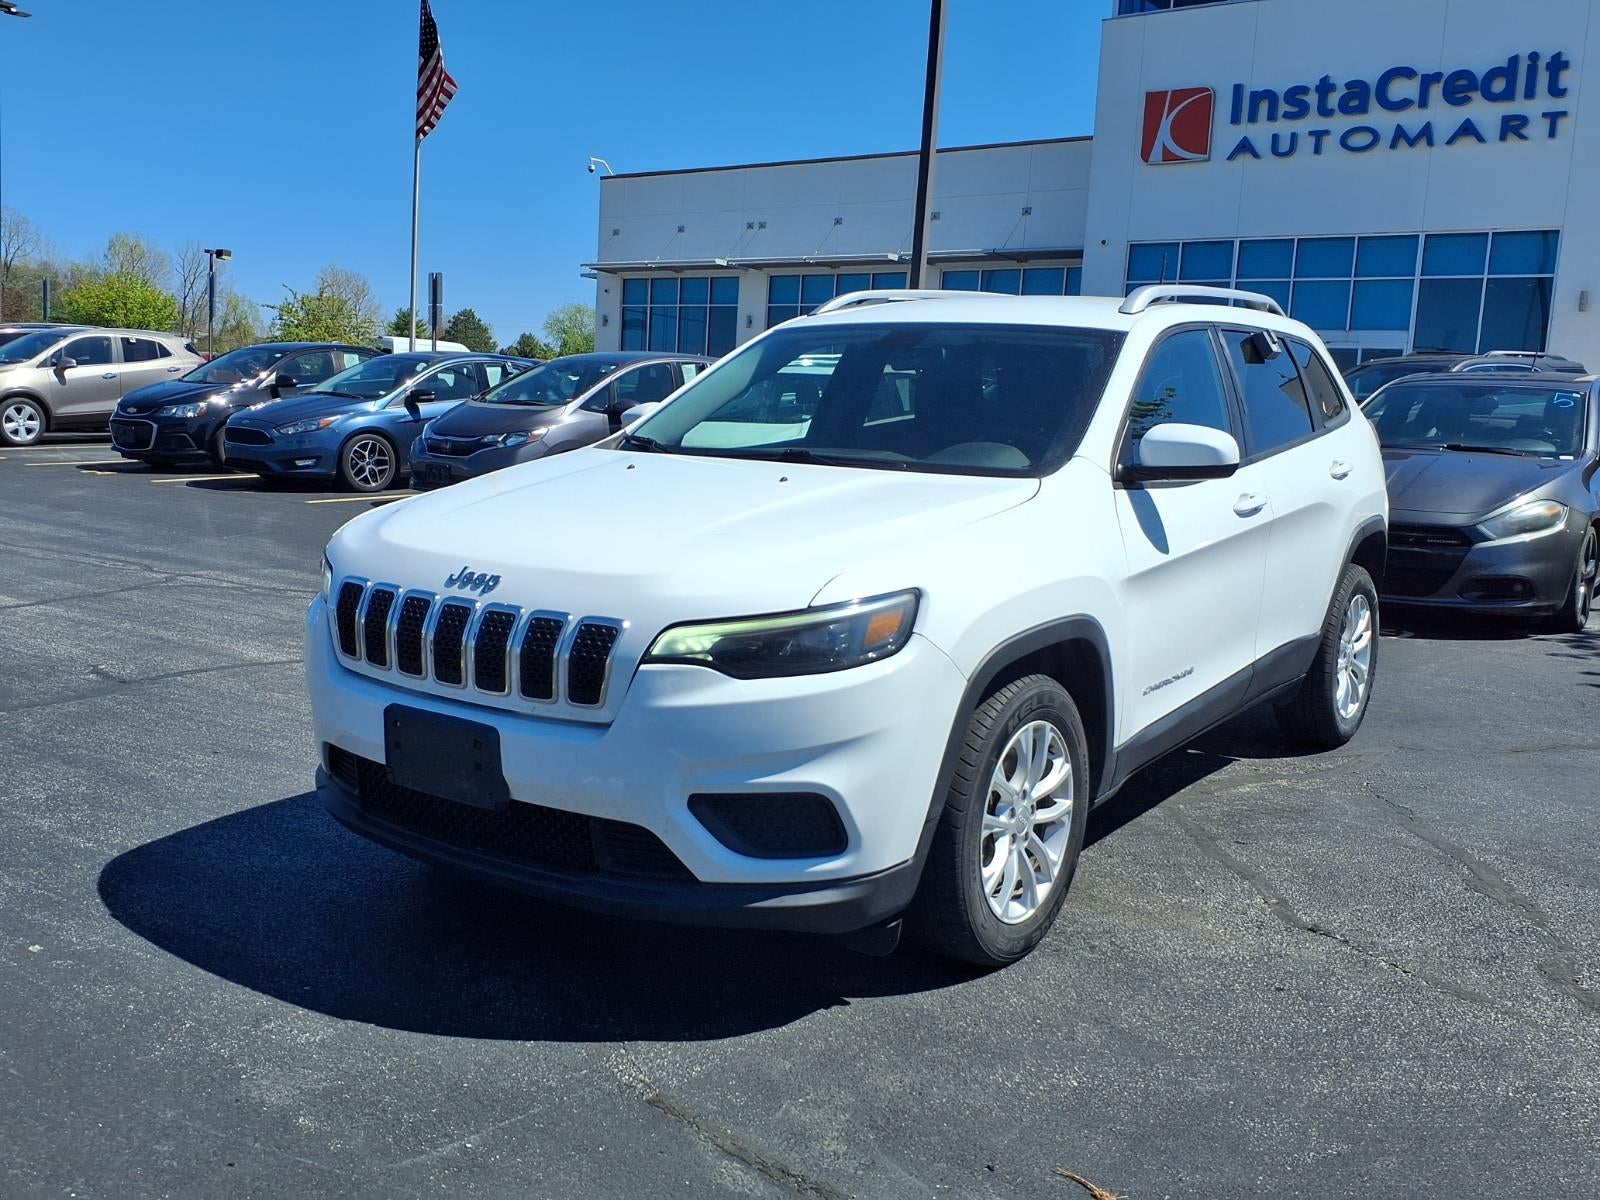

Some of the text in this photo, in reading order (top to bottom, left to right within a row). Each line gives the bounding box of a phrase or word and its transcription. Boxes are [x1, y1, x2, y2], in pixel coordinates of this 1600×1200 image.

[1230, 51, 1569, 125] InstaCredit
[1226, 110, 1568, 161] AUTOMART
[443, 565, 501, 597] Jeep
